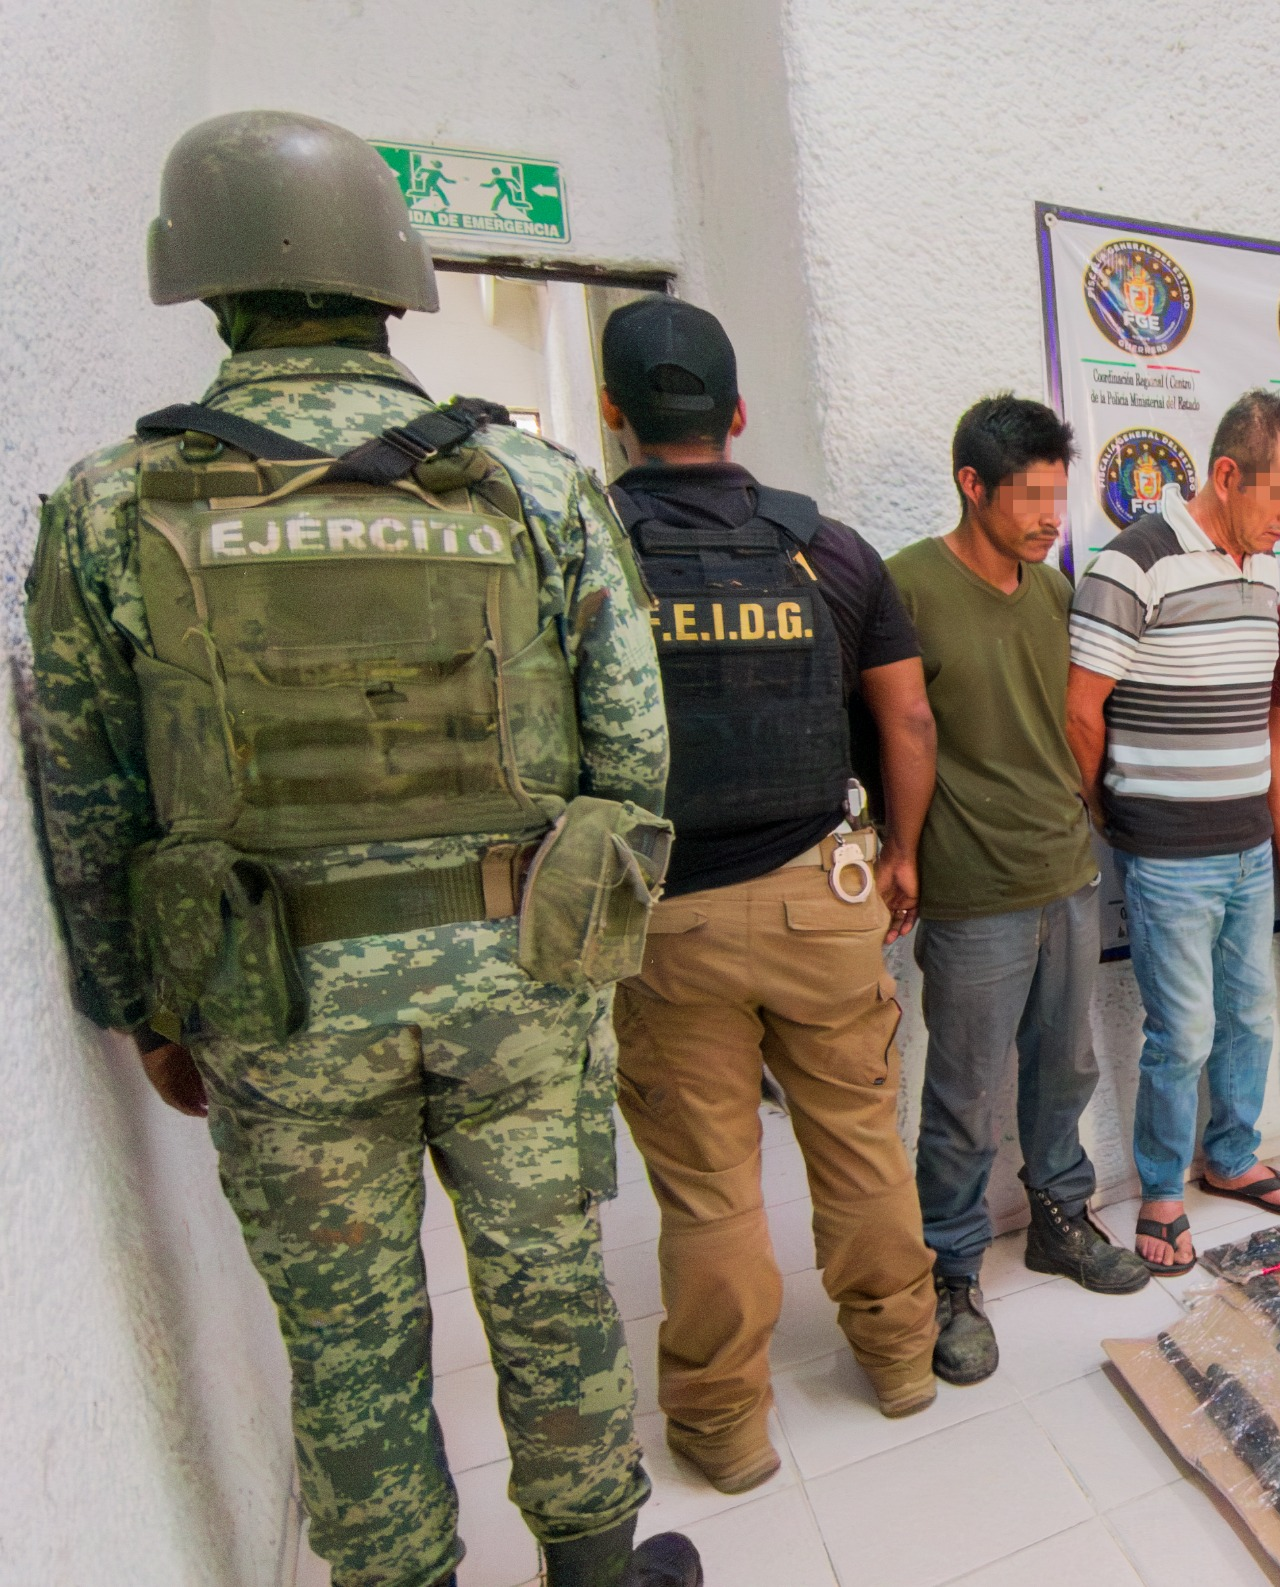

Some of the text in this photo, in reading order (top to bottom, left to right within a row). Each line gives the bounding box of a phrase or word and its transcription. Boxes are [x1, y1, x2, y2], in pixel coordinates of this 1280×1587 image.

[438, 212, 459, 227] DE
[462, 214, 560, 237] EMERGENCIA
[1122, 310, 1160, 331] FGE
[211, 512, 503, 557] EJÉRCITO
